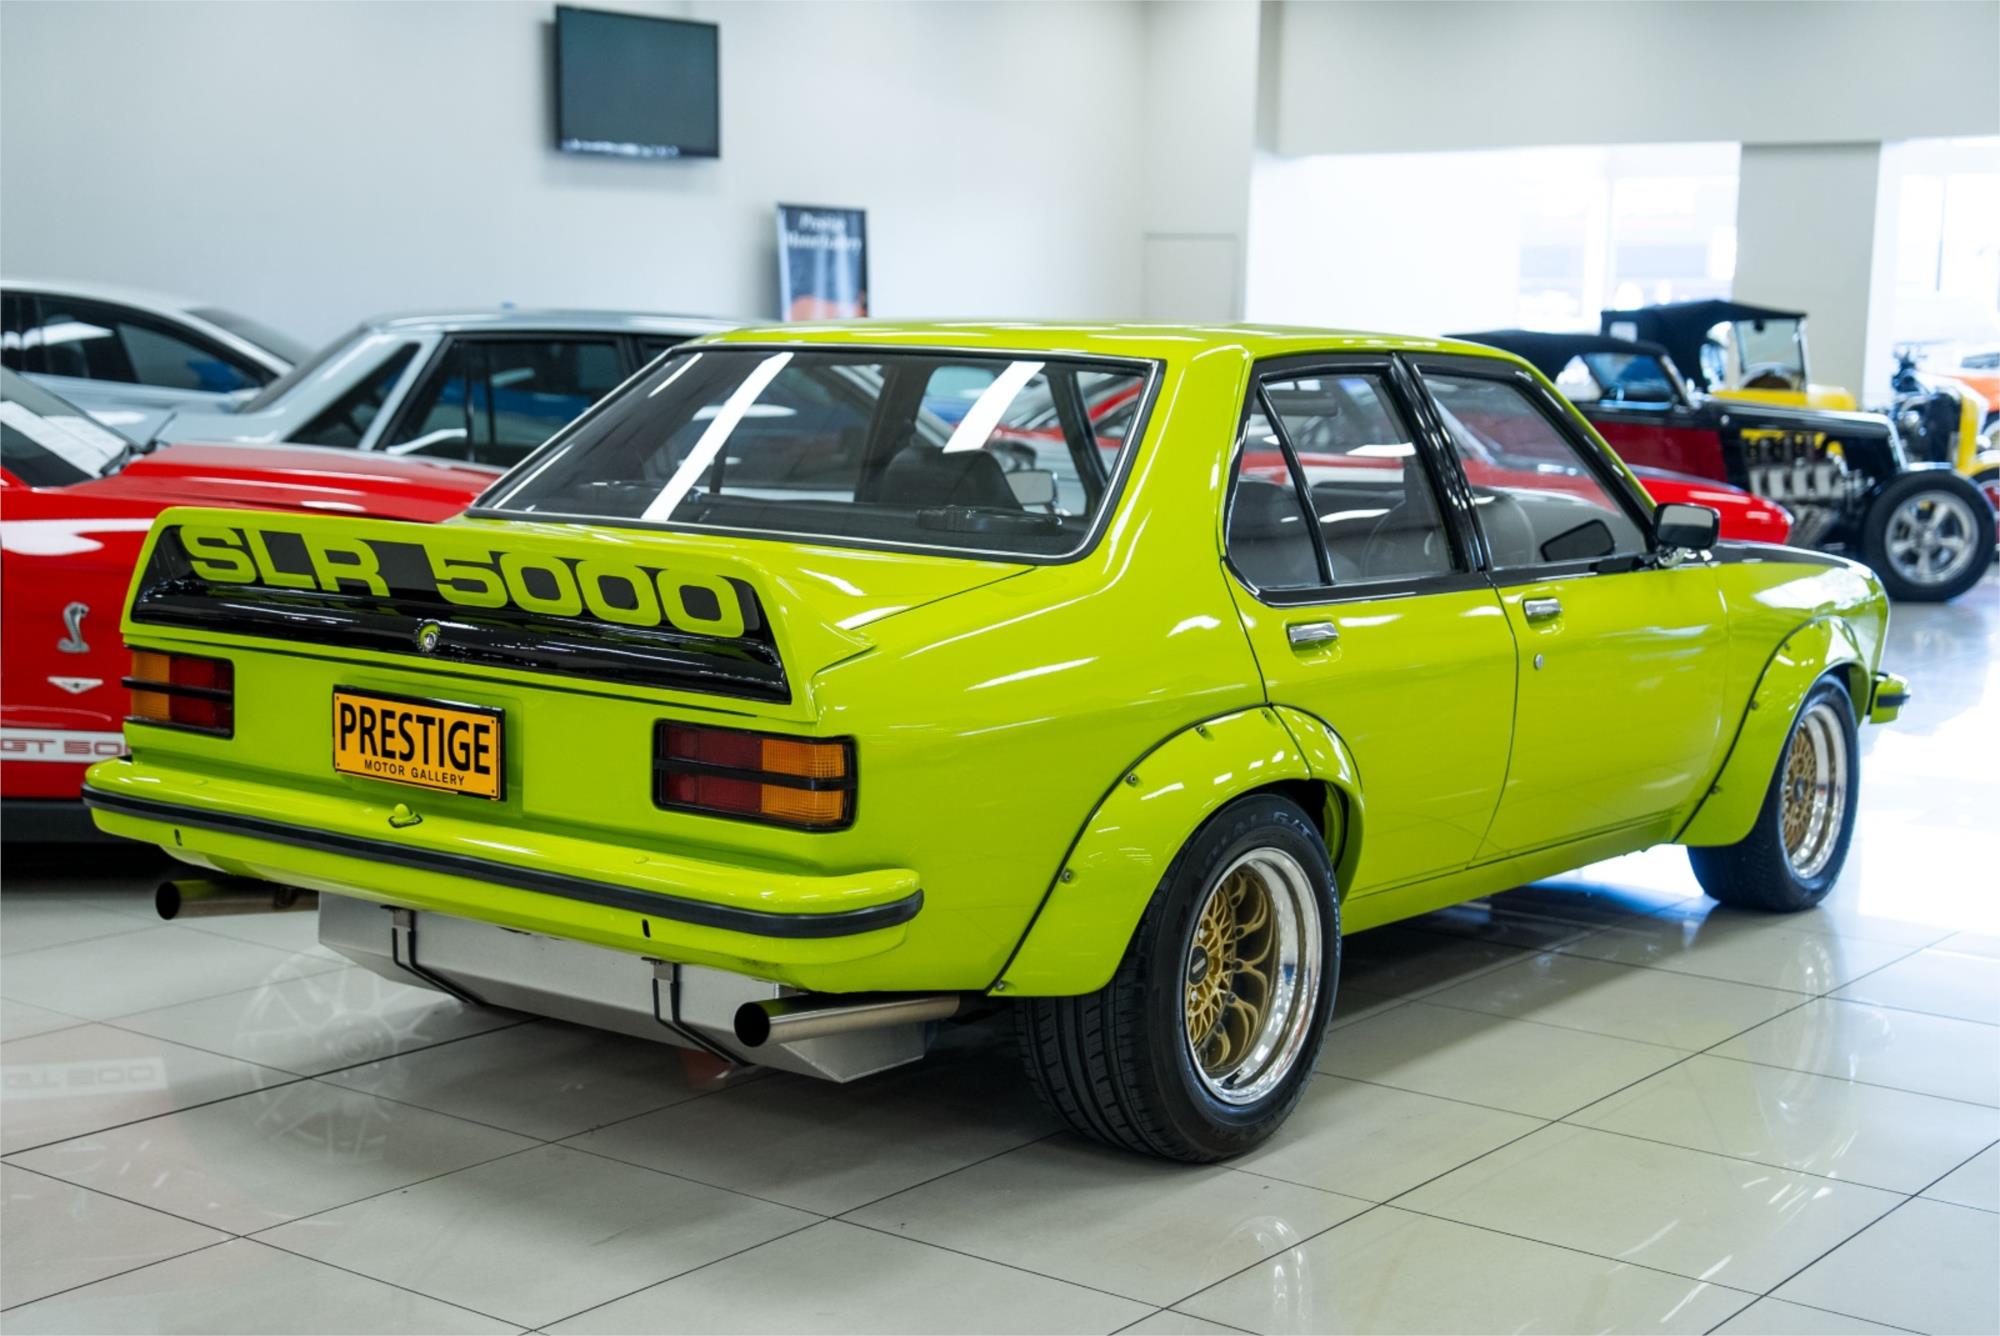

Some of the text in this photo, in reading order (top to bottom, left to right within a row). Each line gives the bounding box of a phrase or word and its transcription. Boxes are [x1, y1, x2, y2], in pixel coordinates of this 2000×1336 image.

[180, 525, 745, 638] SLR 5000
[0, 739, 57, 754] GT
[340, 702, 491, 775] PRESTIGE
[364, 759, 465, 786] MOTOR GALLERY
